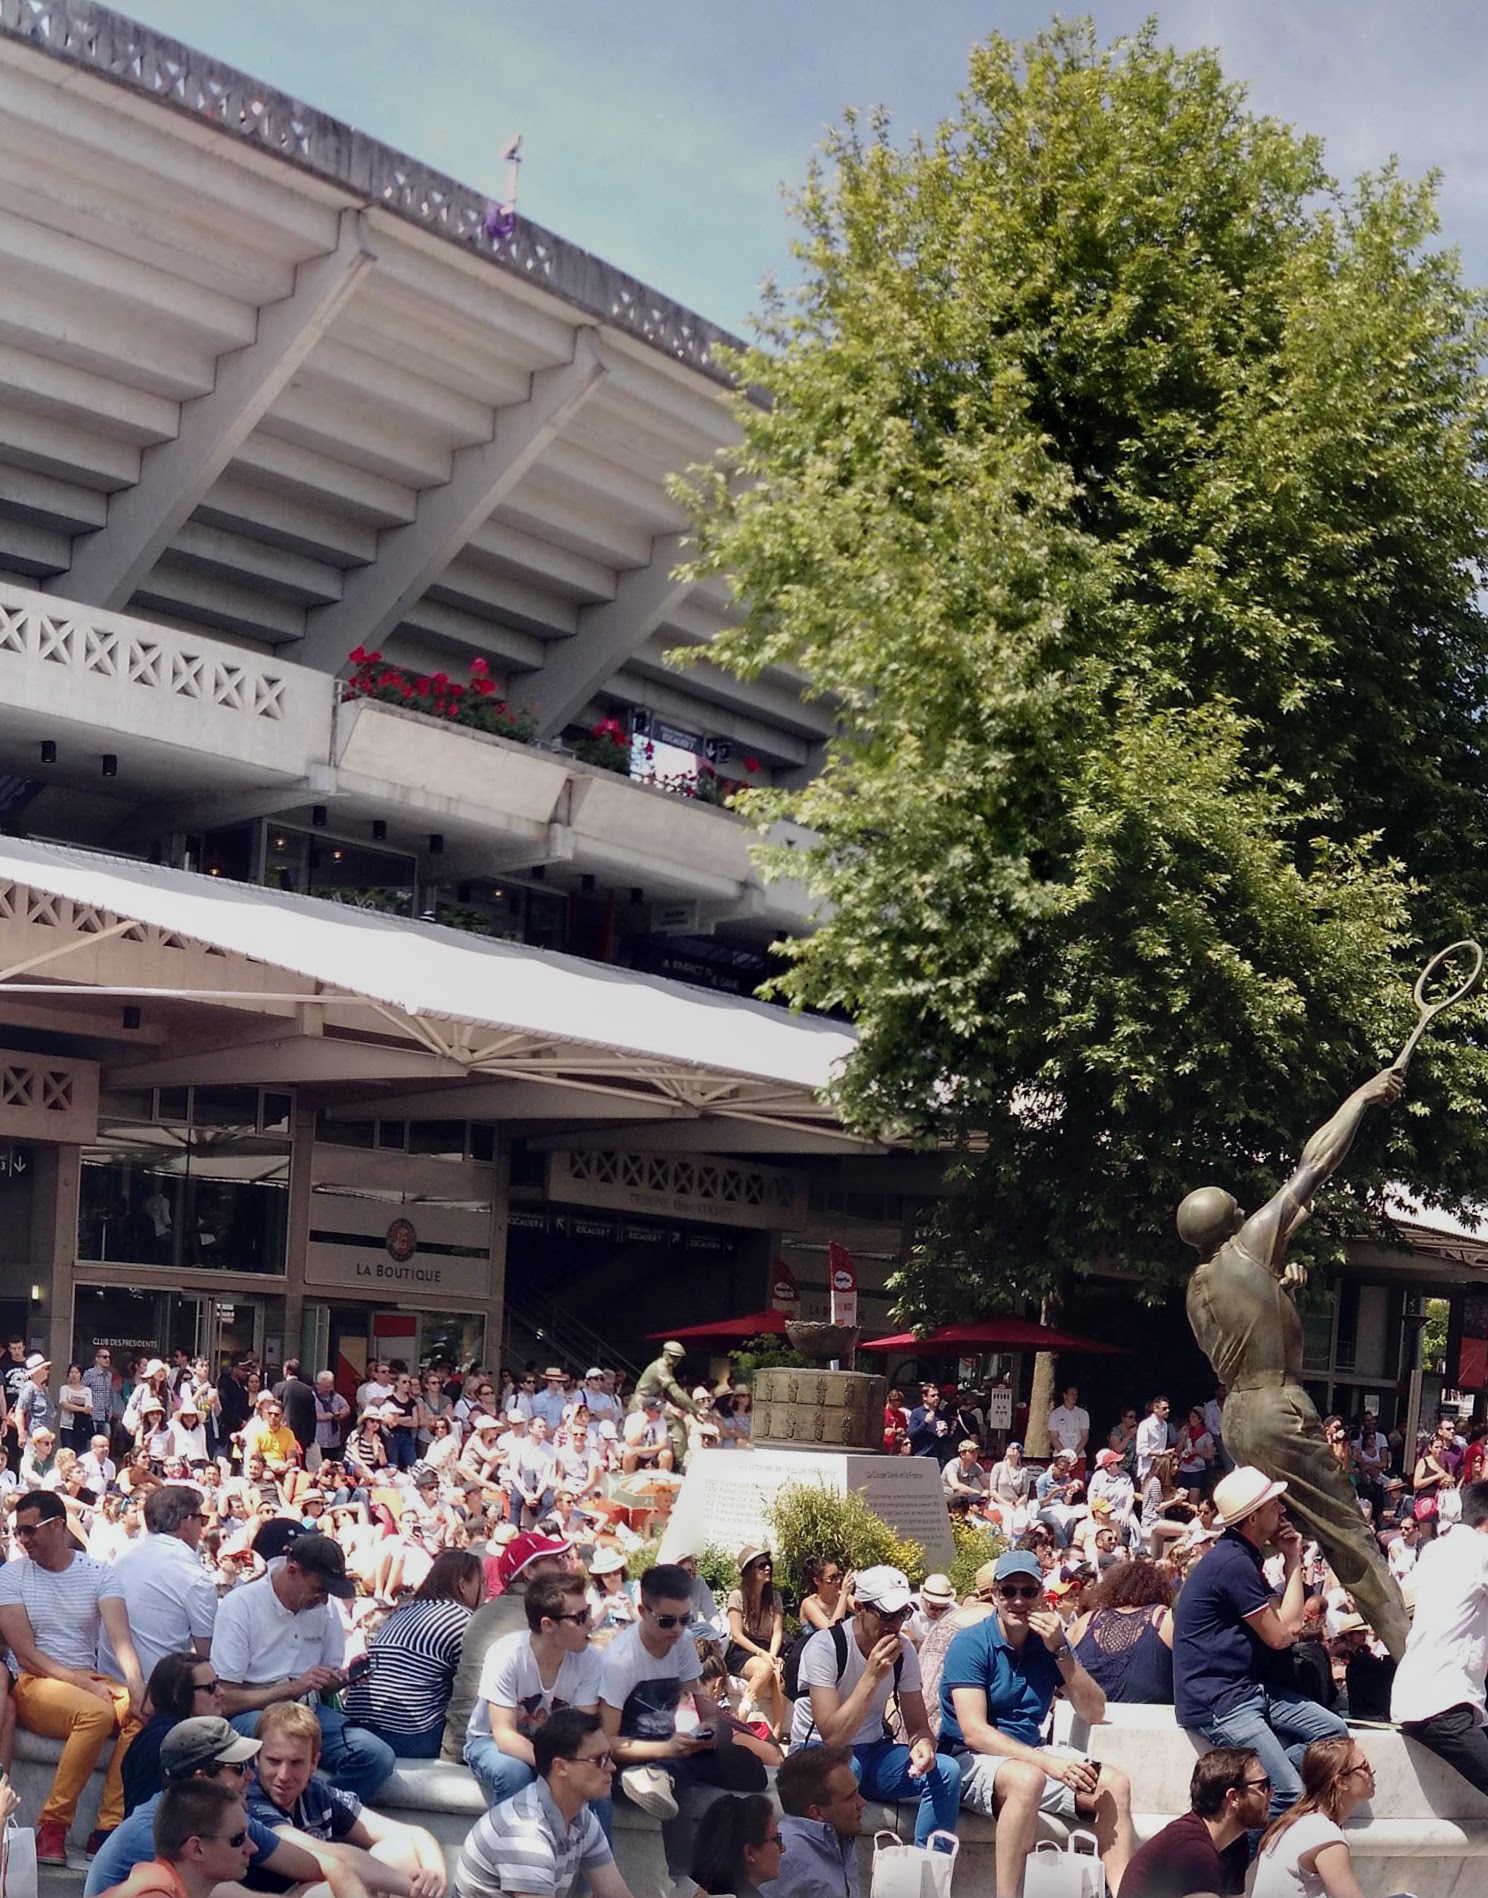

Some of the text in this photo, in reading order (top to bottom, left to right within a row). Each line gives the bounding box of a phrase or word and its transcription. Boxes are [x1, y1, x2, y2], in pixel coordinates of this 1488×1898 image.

[0, 1161, 6, 1171] 3
[356, 1262, 441, 1282] LA BOUTIQUE
[92, 1337, 158, 1348] CLUB DES PRESIDENTS
